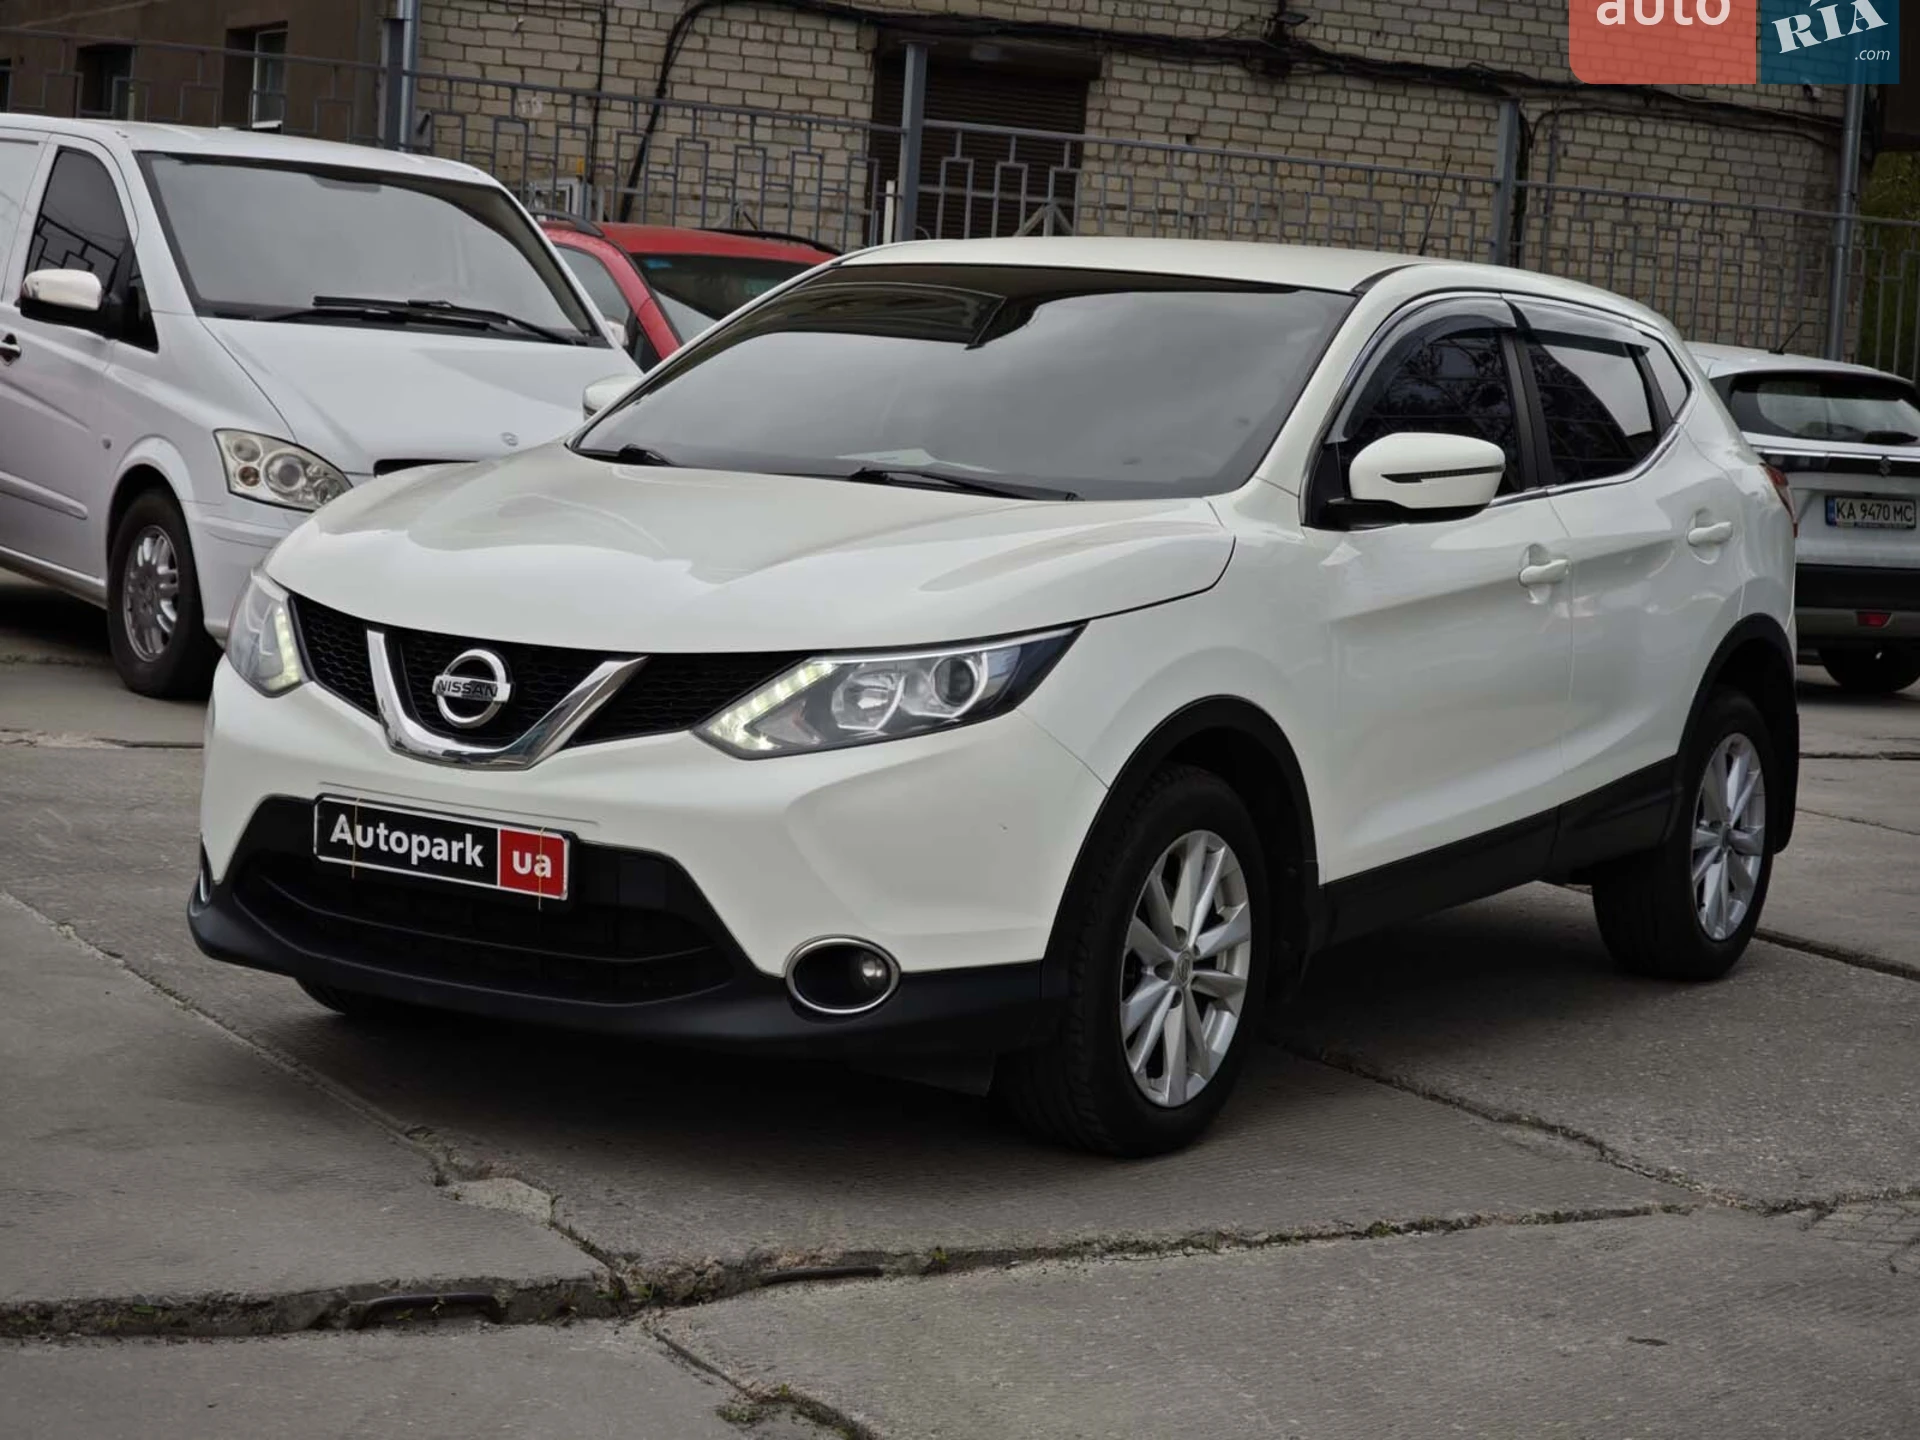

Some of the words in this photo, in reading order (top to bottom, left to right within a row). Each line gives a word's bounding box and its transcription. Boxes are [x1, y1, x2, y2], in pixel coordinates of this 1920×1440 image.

[1836, 501, 1856, 519] KA
[1860, 502, 1890, 521] 9470
[1893, 504, 1913, 523] MC
[436, 679, 498, 698] NISSAN
[329, 813, 485, 868] Autopark
[512, 849, 553, 879] ua
